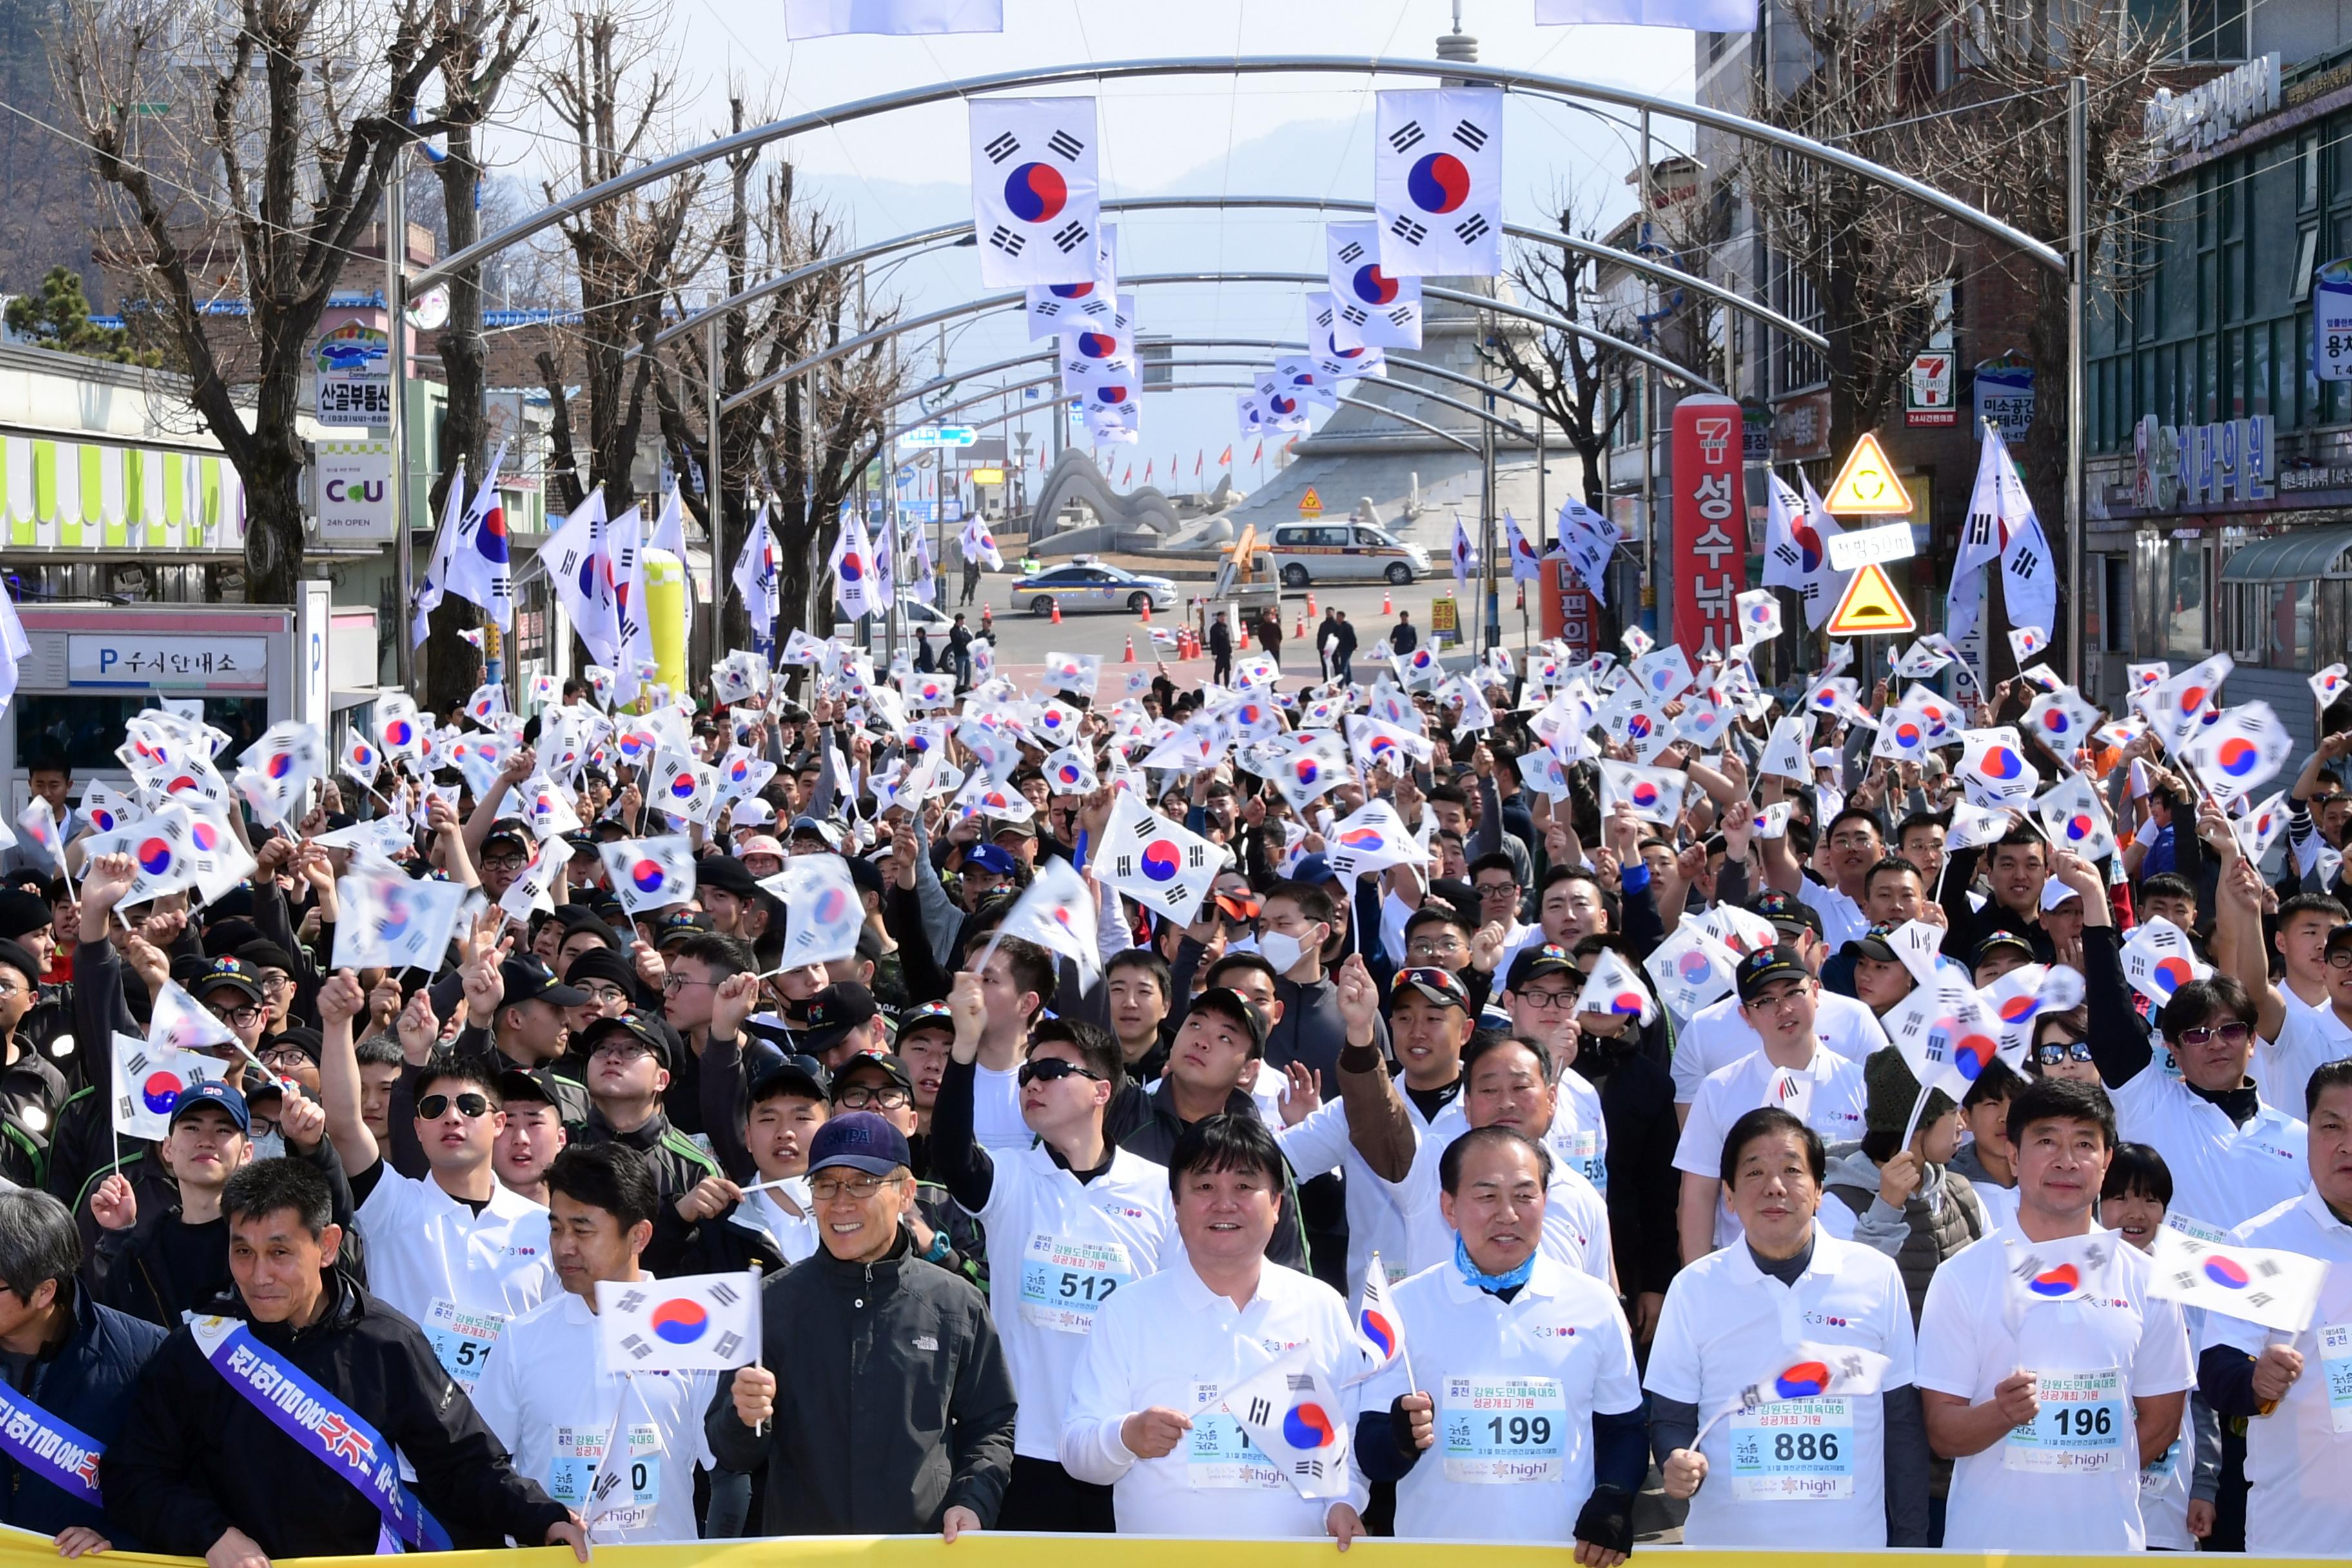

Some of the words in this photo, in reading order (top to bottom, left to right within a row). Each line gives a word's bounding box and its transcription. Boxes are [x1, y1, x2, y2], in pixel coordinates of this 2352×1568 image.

[326, 479, 383, 502] CU
[1692, 473, 1734, 661] 성수낚시
[100, 649, 118, 674] P
[1584, 1159, 1605, 1181] 536
[1034, 1240, 1051, 1251] 홍천
[1052, 1255, 1086, 1268] 성공개최
[1089, 1259, 1106, 1271] 기원
[1059, 1272, 1118, 1302] 512
[434, 1307, 454, 1320] 홍천
[453, 1322, 487, 1339] 성공개최
[2326, 1334, 2347, 1348] 홍천
[2041, 1378, 2117, 1391] 강원도민체육대회
[1450, 1387, 1470, 1398] 홍천
[1473, 1387, 1557, 1398] 강원도민체육대회
[2039, 1389, 2079, 1402] 성공개최
[2082, 1389, 2099, 1401] 기원
[1473, 1398, 1512, 1409] 성공개최
[1515, 1398, 1534, 1409] 기원
[1760, 1404, 1845, 1416] 강원도민체육대회
[1759, 1415, 1799, 1426] 성공개최
[1802, 1415, 1821, 1426] 기원
[2053, 1406, 2112, 1437] 196
[1487, 1416, 1552, 1446] 199
[558, 1435, 573, 1446] 홍천
[1774, 1433, 1839, 1462] 886
[575, 1446, 603, 1457] 성공개
